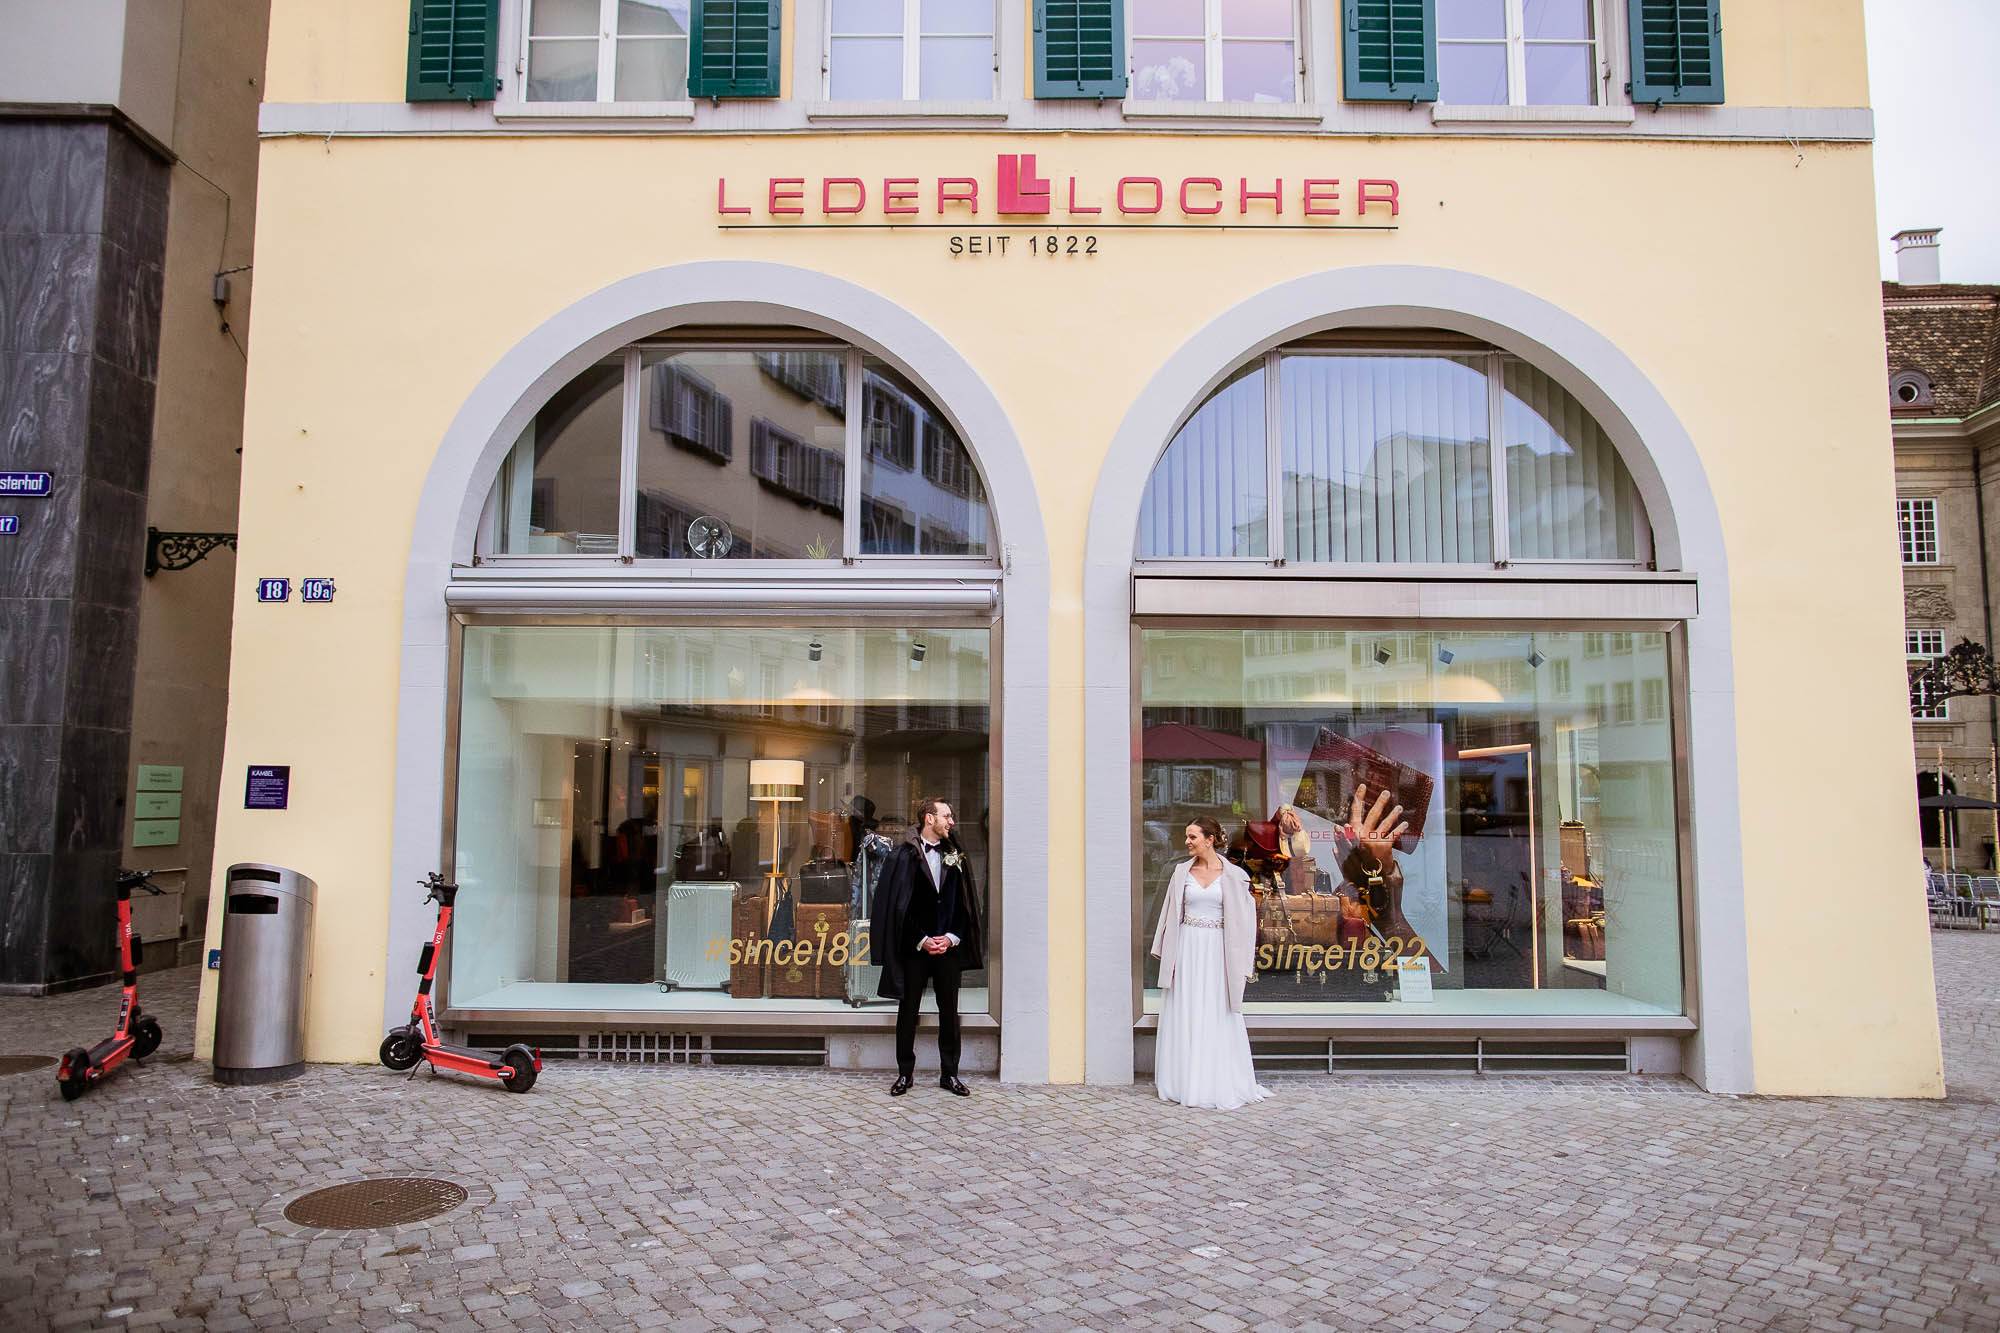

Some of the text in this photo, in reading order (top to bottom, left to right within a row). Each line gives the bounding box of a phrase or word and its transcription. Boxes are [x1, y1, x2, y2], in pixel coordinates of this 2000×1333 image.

[718, 177, 978, 214] LEDER
[1069, 177, 1399, 215] LOCHER
[949, 235, 1098, 253] SEIT 1822
[0, 518, 14, 531] 17
[265, 581, 283, 599] 18
[305, 581, 330, 599] 19a
[704, 931, 871, 966] #since182
[1256, 936, 1427, 970] since1822
